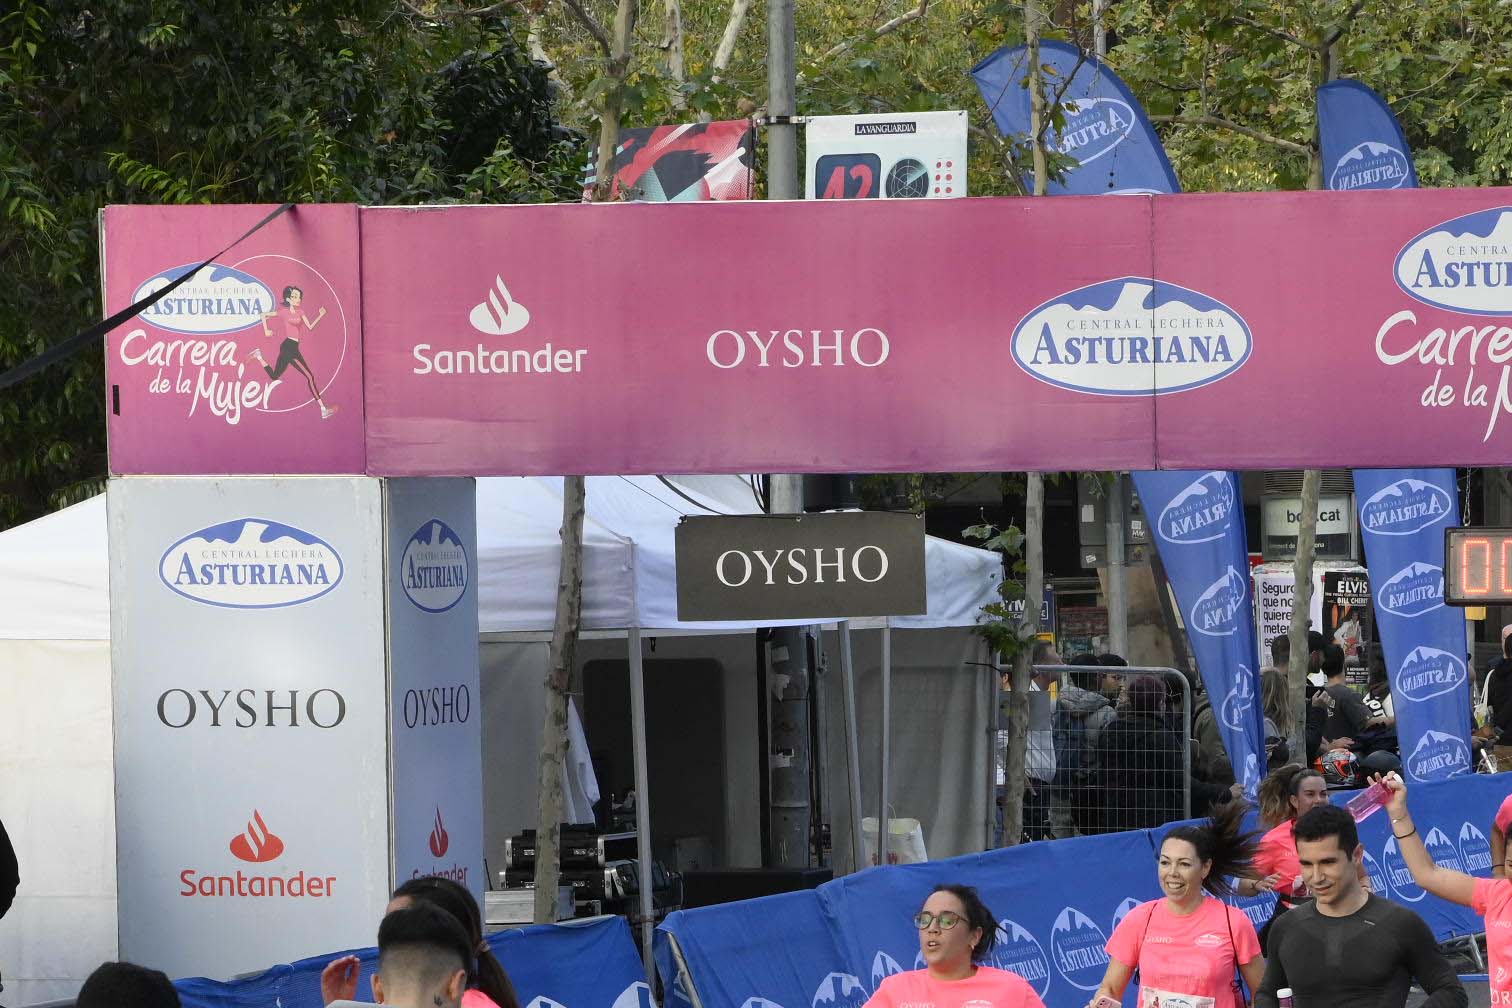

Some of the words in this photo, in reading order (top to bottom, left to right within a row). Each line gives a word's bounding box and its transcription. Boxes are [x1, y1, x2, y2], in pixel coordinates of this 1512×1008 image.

[855, 124, 867, 135] LA
[867, 122, 915, 134] VANGUARDIA
[1066, 318, 1144, 330] CENTRAL
[1149, 317, 1226, 330] LECHERA
[119, 329, 238, 367] Carrera
[413, 342, 587, 375] Santander
[706, 327, 890, 369] OYSHO
[1029, 320, 1234, 366] ASTURIANA
[149, 368, 171, 394] de
[176, 367, 192, 394] la
[188, 363, 283, 425] Mujer
[1420, 367, 1457, 409] de
[1462, 367, 1489, 408] la
[174, 551, 331, 586] ASTURIANA
[201, 549, 259, 560] CENTRAL
[265, 549, 325, 560] LECHERA
[406, 549, 465, 590] ASTURIANA
[715, 545, 890, 588] OYSHO
[1263, 597, 1280, 608] que
[1338, 581, 1368, 594] ELVIS
[156, 688, 347, 729] OYSHO
[403, 683, 470, 729] OYSHO
[180, 869, 337, 897] Santander
